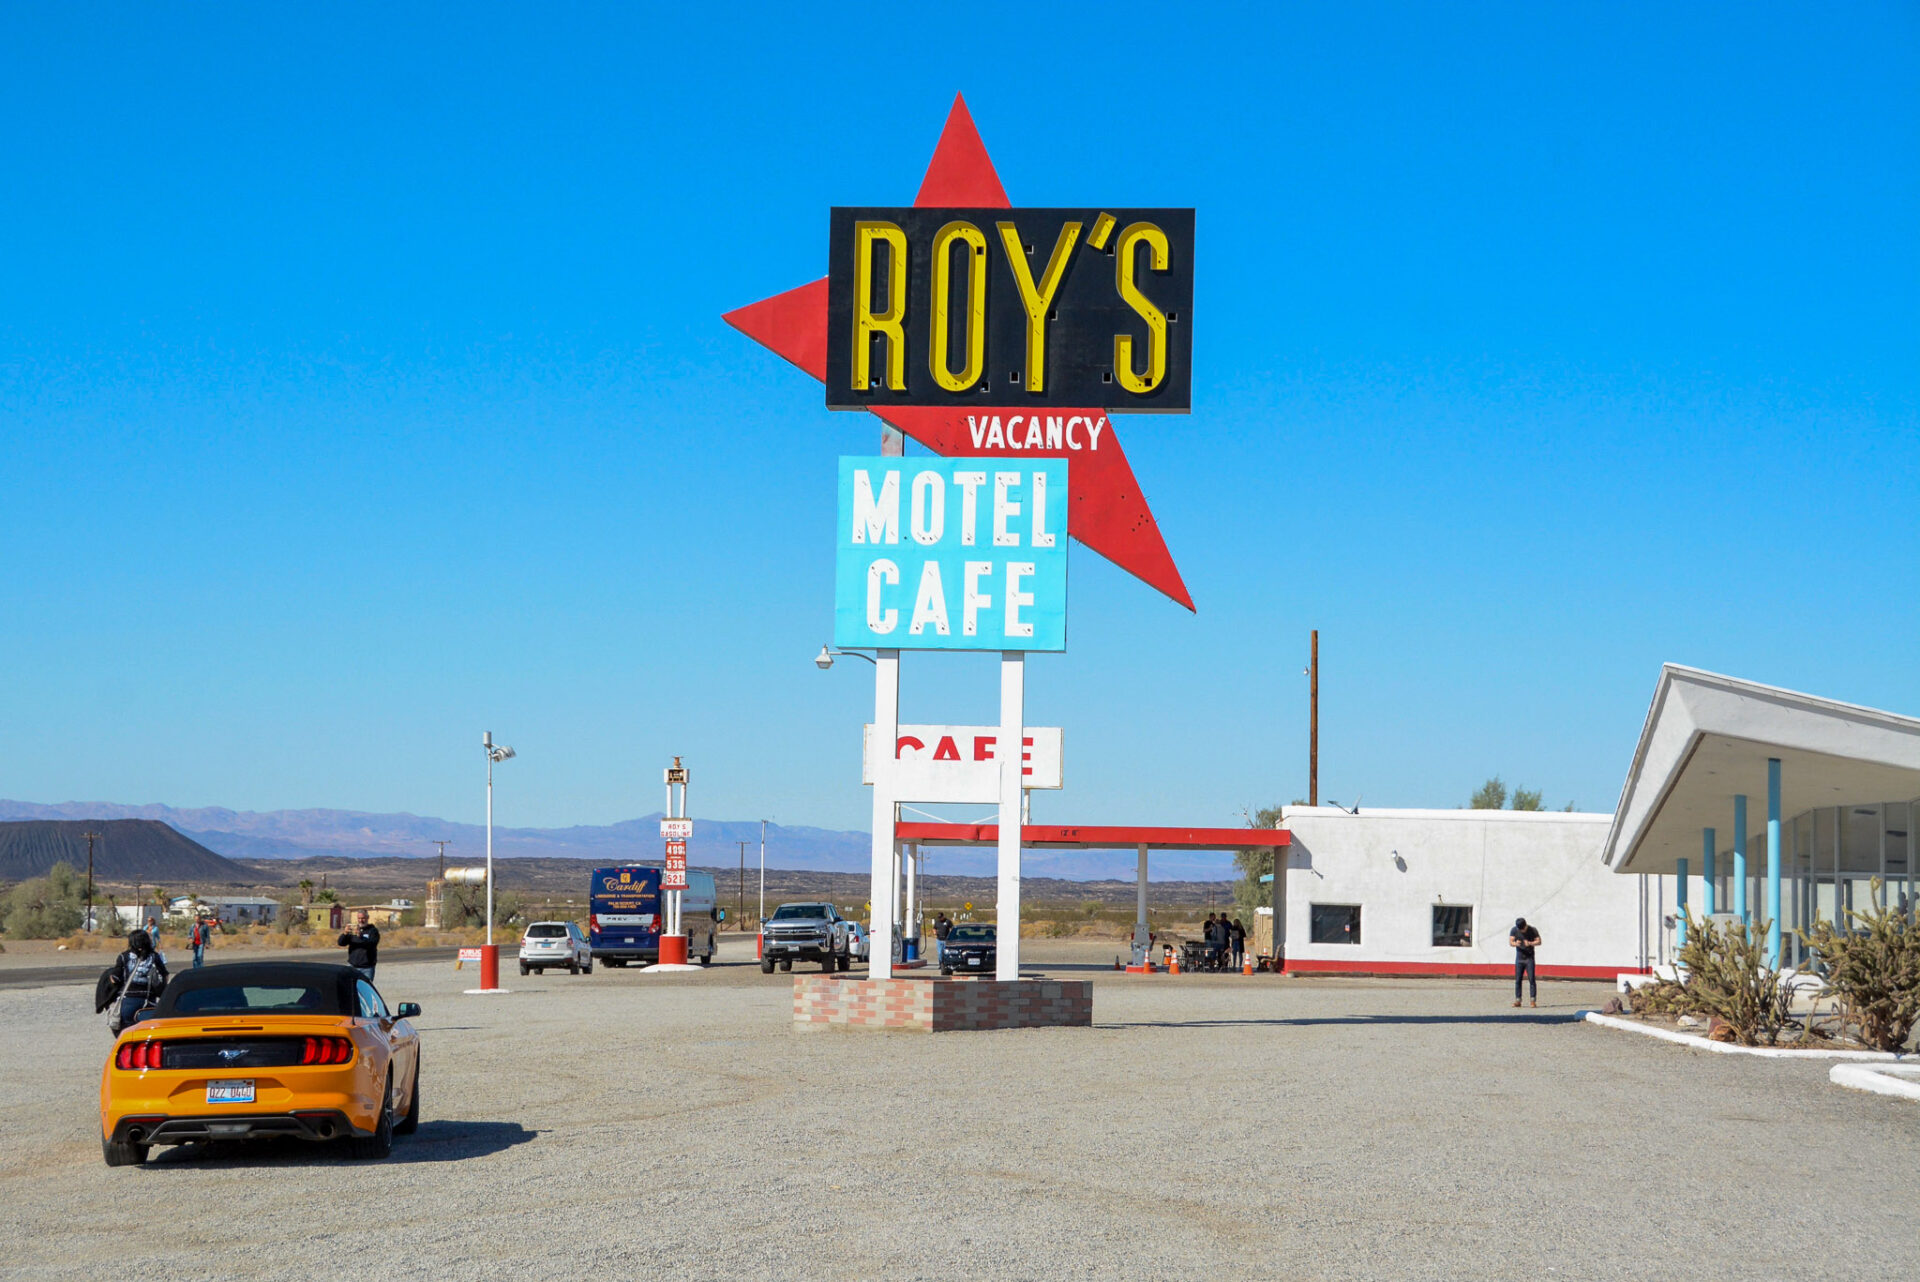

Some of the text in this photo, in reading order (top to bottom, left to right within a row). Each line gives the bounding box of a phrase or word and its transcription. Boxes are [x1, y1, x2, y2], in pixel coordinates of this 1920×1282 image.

[851, 212, 1169, 394] ROY'S
[967, 415, 1106, 451] VACANCY
[852, 469, 1056, 547] MOTEL
[866, 558, 1035, 637] CAFE
[602, 877, 648, 893] Cardiff
